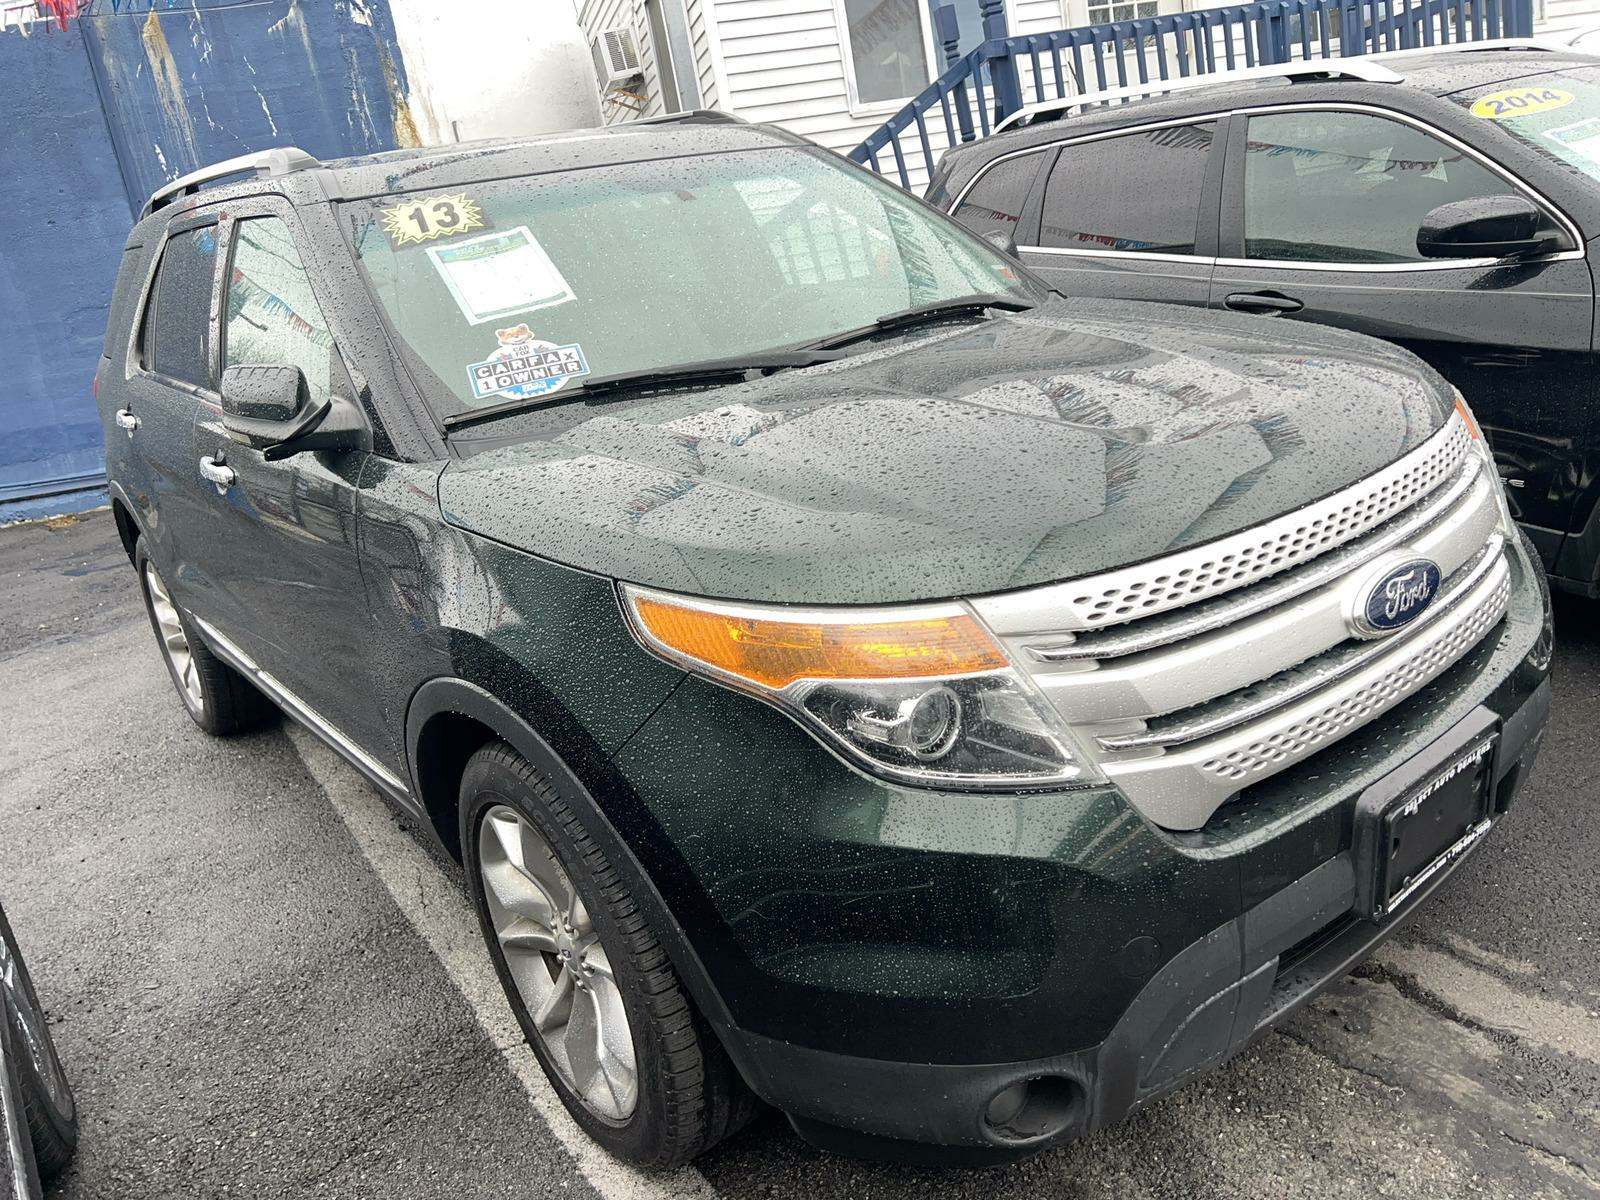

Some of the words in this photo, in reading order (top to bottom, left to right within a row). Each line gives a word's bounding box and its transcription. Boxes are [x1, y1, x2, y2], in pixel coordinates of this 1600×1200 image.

[1485, 90, 1560, 115] 2014
[408, 202, 460, 233] 13
[476, 351, 576, 378] CARFAX
[482, 380, 492, 391] 1
[498, 361, 580, 386] OWNER
[1385, 570, 1430, 619] Ford
[1404, 786, 1433, 816] SELECT
[1433, 768, 1456, 792] AUTO
[1457, 741, 1491, 774] DEALERS
